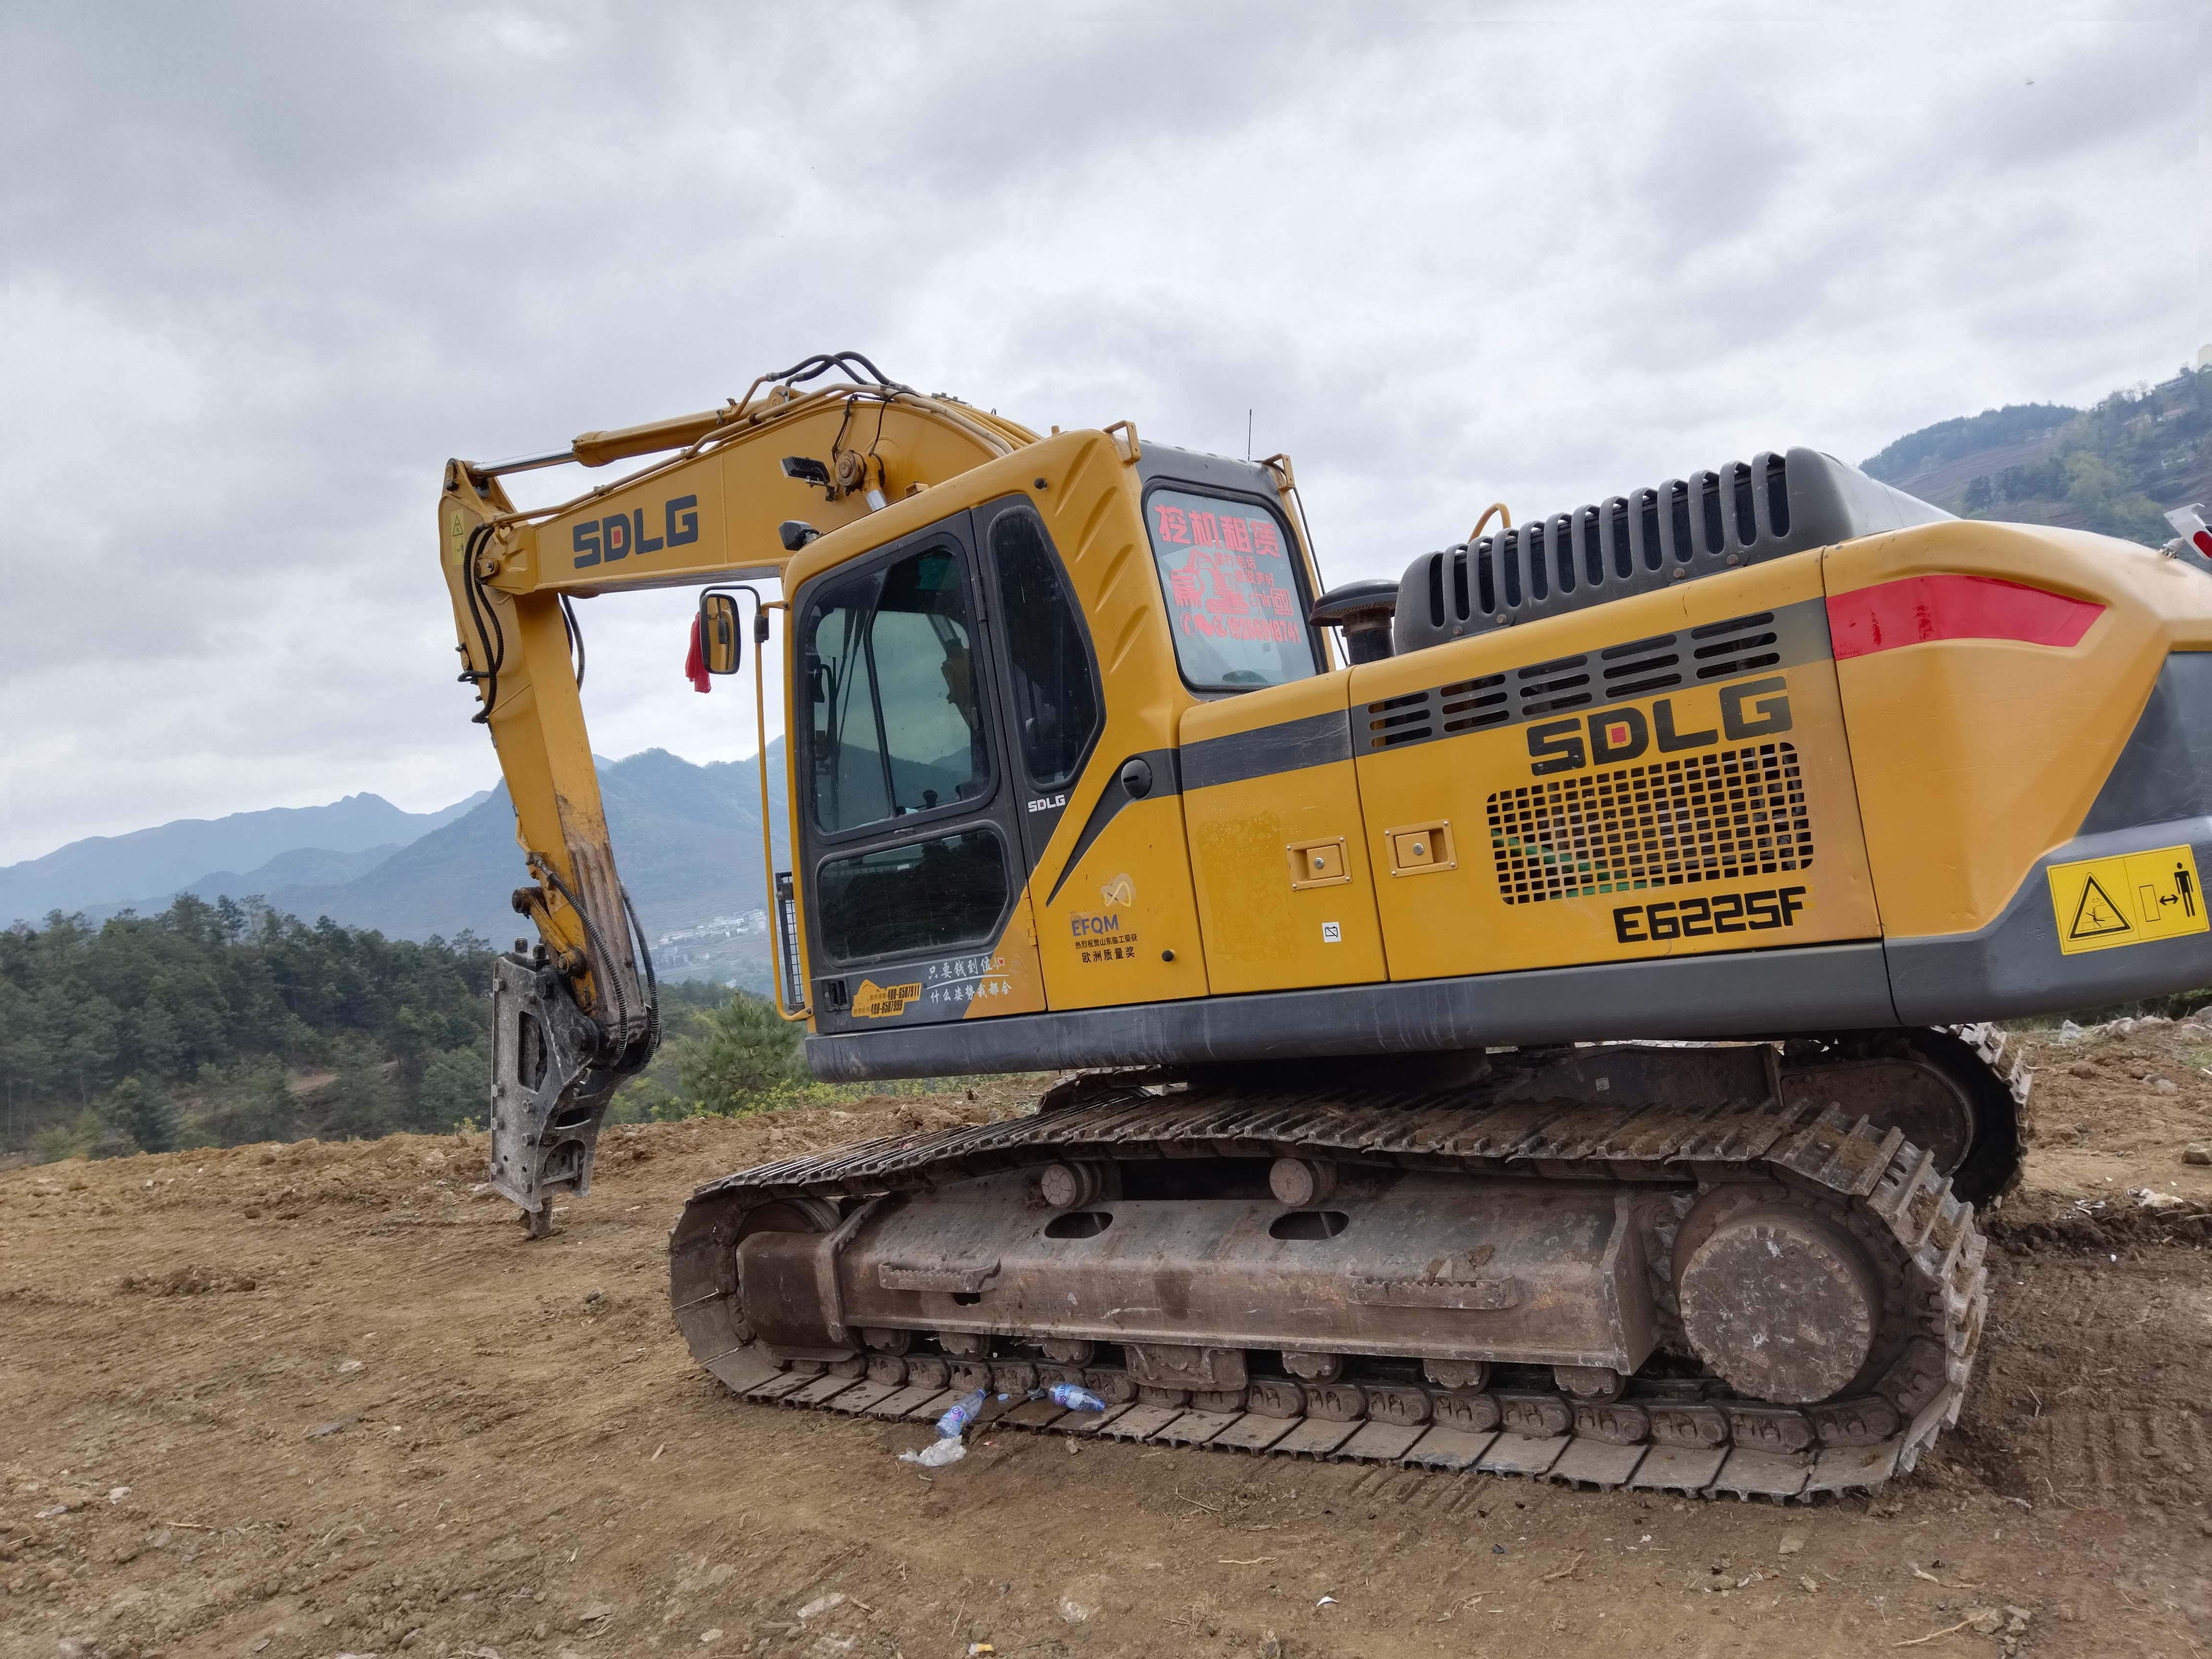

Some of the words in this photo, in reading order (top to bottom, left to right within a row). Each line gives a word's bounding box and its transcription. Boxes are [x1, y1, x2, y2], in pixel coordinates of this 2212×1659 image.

[573, 494, 698, 569] SDLG
[1154, 504, 1281, 558] 挖机租赁
[1527, 676, 1793, 776] SDLG
[1028, 794, 1066, 812] SDLG
[1071, 914, 1119, 937] EFQM
[1612, 886, 1806, 944] E6225F
[1075, 934, 1138, 949] 热烈祝贺山东临工荣获
[1082, 946, 1135, 963] 欧洲质量奖
[928, 956, 993, 980] 只要钱到位
[887, 985, 920, 1000] 400-6587911
[930, 980, 1012, 1004] 什么姿势我都会
[870, 999, 903, 1015] 400-6587999
